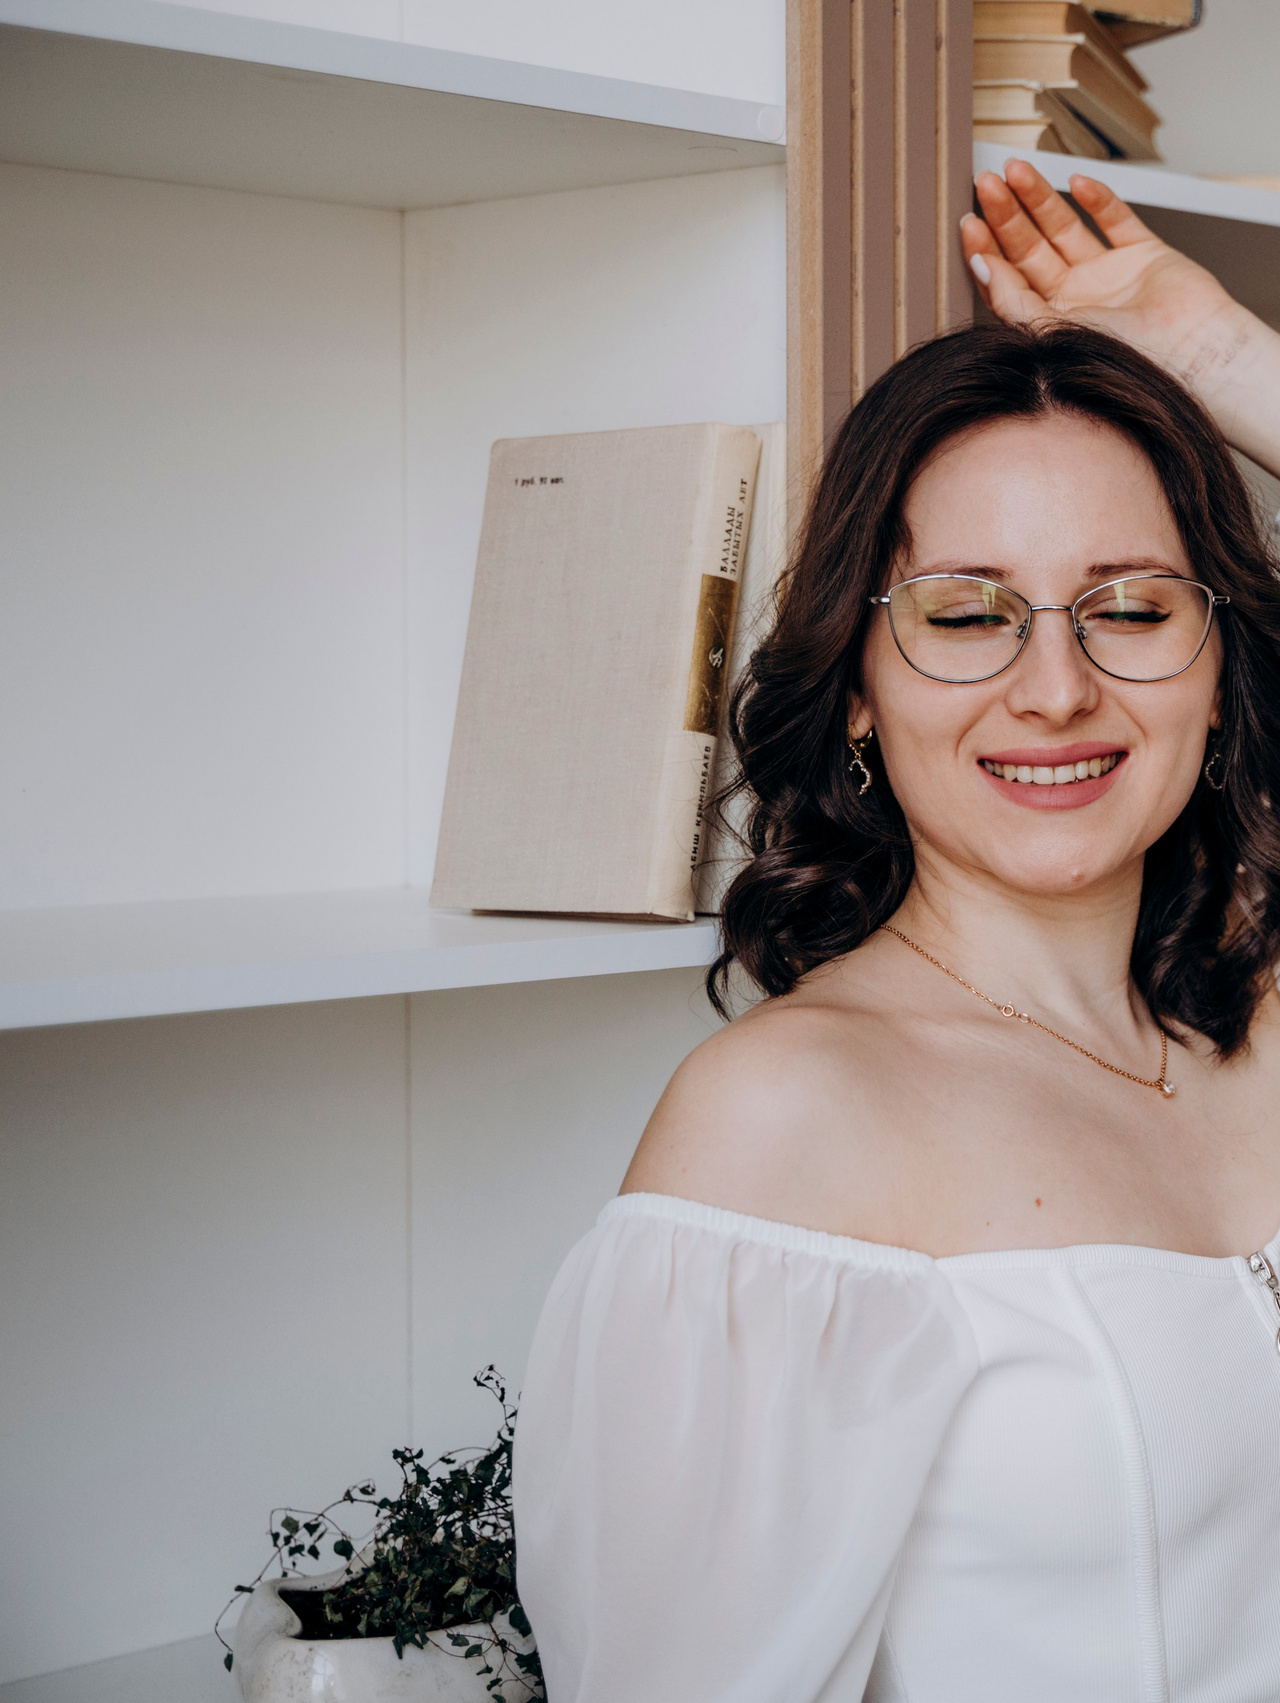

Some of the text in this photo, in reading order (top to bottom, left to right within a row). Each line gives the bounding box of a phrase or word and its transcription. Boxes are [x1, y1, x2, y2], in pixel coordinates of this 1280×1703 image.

[720, 506, 736, 574] БАЛЛАДЫ
[729, 478, 748, 576] ЗАБЫТЫХ ЛЕТ
[690, 834, 700, 872] АБИШ
